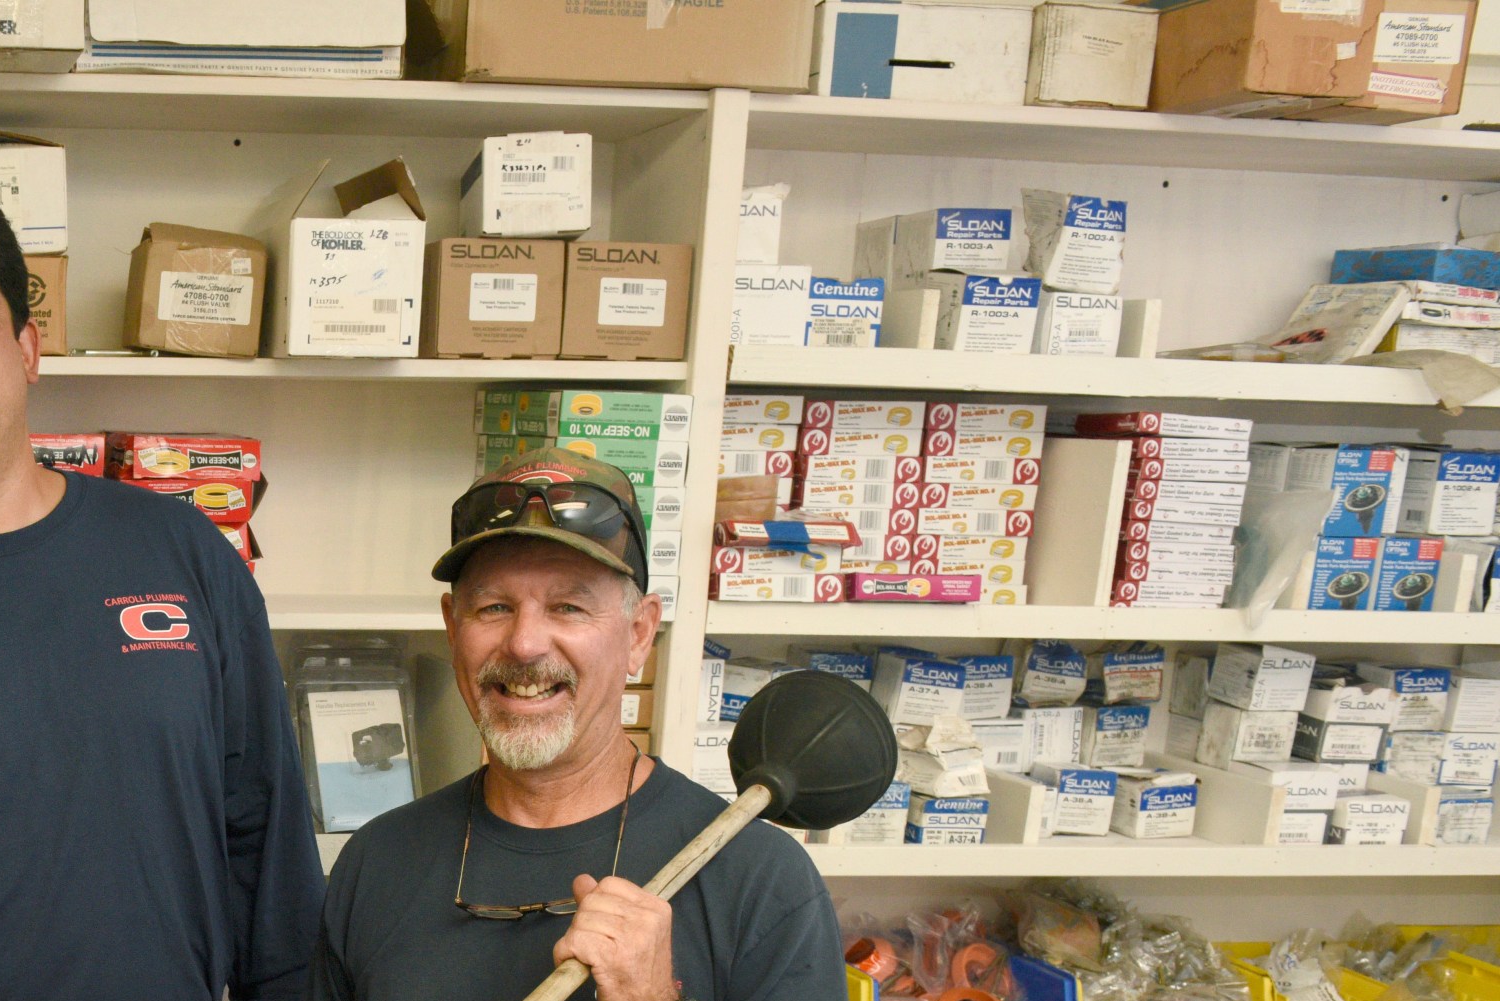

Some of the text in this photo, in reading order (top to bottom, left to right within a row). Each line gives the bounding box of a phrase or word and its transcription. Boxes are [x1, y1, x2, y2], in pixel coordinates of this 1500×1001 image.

[1076, 207, 1124, 223] SLOAN
[947, 219, 1005, 232] SLOAN
[1074, 219, 1123, 230] Repair Parts
[311, 230, 364, 240] THE BOLD LOOK
[946, 231, 1002, 239] Repair Parts
[1070, 231, 1115, 242] R-1003-A
[321, 239, 364, 251] KOHLER
[946, 242, 994, 250] R-1003-A
[450, 244, 533, 260] SLOAN
[577, 247, 659, 264] SLOAN
[735, 277, 805, 291] SLOAN
[813, 281, 879, 297] Genuine
[973, 285, 1032, 299] SLOAN
[972, 297, 1030, 306] Repair Parts
[1056, 296, 1119, 310] SLOAN
[810, 304, 879, 319] SLOAN
[971, 310, 1020, 318] R-1003-A
[663, 414, 689, 423] HARVEY
[569, 424, 581, 435] 10
[583, 424, 600, 436] NO.
[657, 460, 683, 469] HARVEY
[1446, 463, 1496, 475] SLOAN
[652, 550, 677, 558] HARVEY
[104, 594, 188, 607] CARROLL PLUMBING
[119, 603, 190, 641] C
[121, 641, 199, 653] & MAINTENANCE INC.
[817, 664, 866, 674] SLOAN
[966, 663, 1007, 674] SLOAN
[1035, 656, 1083, 671] SLOAN
[1261, 658, 1312, 670] SLOAN
[911, 667, 958, 682] SLOAN
[1401, 677, 1445, 686] SLOAN
[707, 662, 722, 722] SLOAN
[908, 685, 941, 696] A-37-A
[1339, 700, 1386, 710] SLOAN
[1103, 714, 1144, 725] SLOAN
[1071, 710, 1083, 763] SLOAN
[1453, 742, 1496, 751] SLOAN
[1064, 778, 1110, 790] SLOAN
[1148, 793, 1193, 804] SLOAN
[934, 799, 984, 811] Genuine
[1348, 803, 1406, 814] SLOAN
[928, 815, 980, 825] SLOAN
